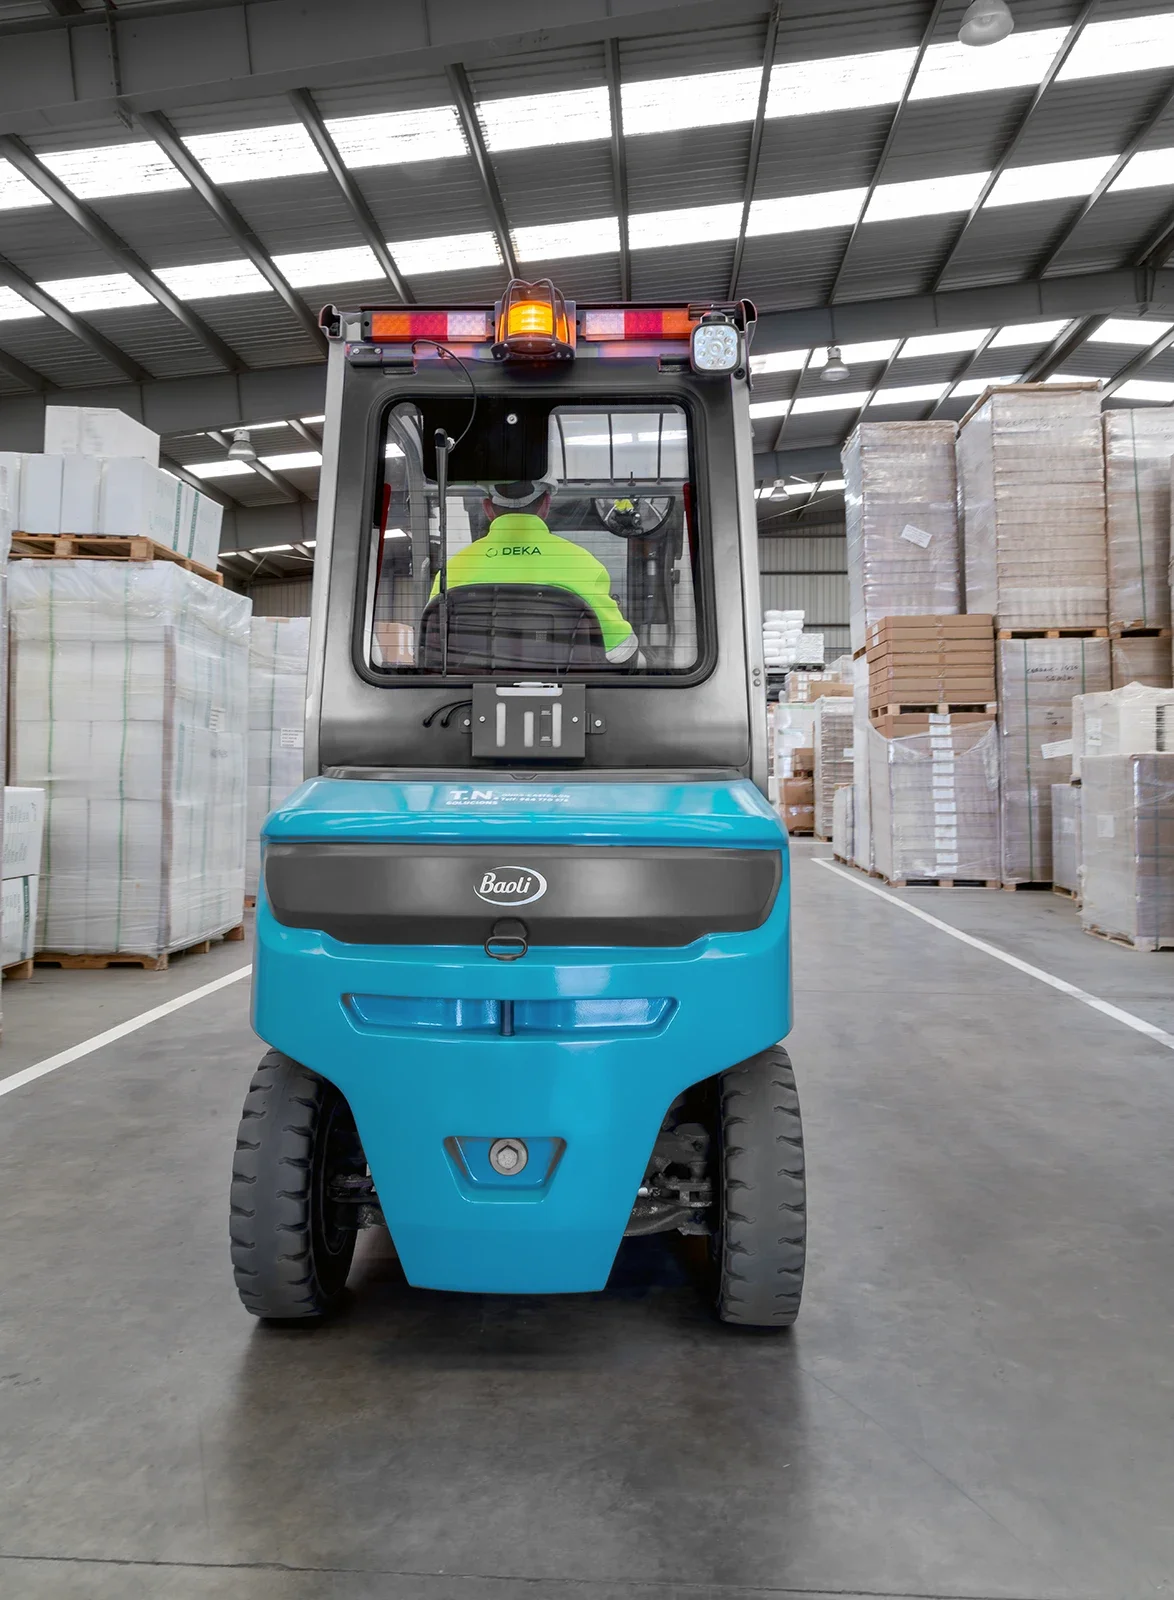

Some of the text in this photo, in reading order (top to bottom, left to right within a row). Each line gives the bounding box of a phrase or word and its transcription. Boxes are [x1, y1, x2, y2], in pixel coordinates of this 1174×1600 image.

[502, 546, 542, 556] DEKA
[449, 790, 500, 800] T.N.
[479, 872, 532, 893] Baoli
